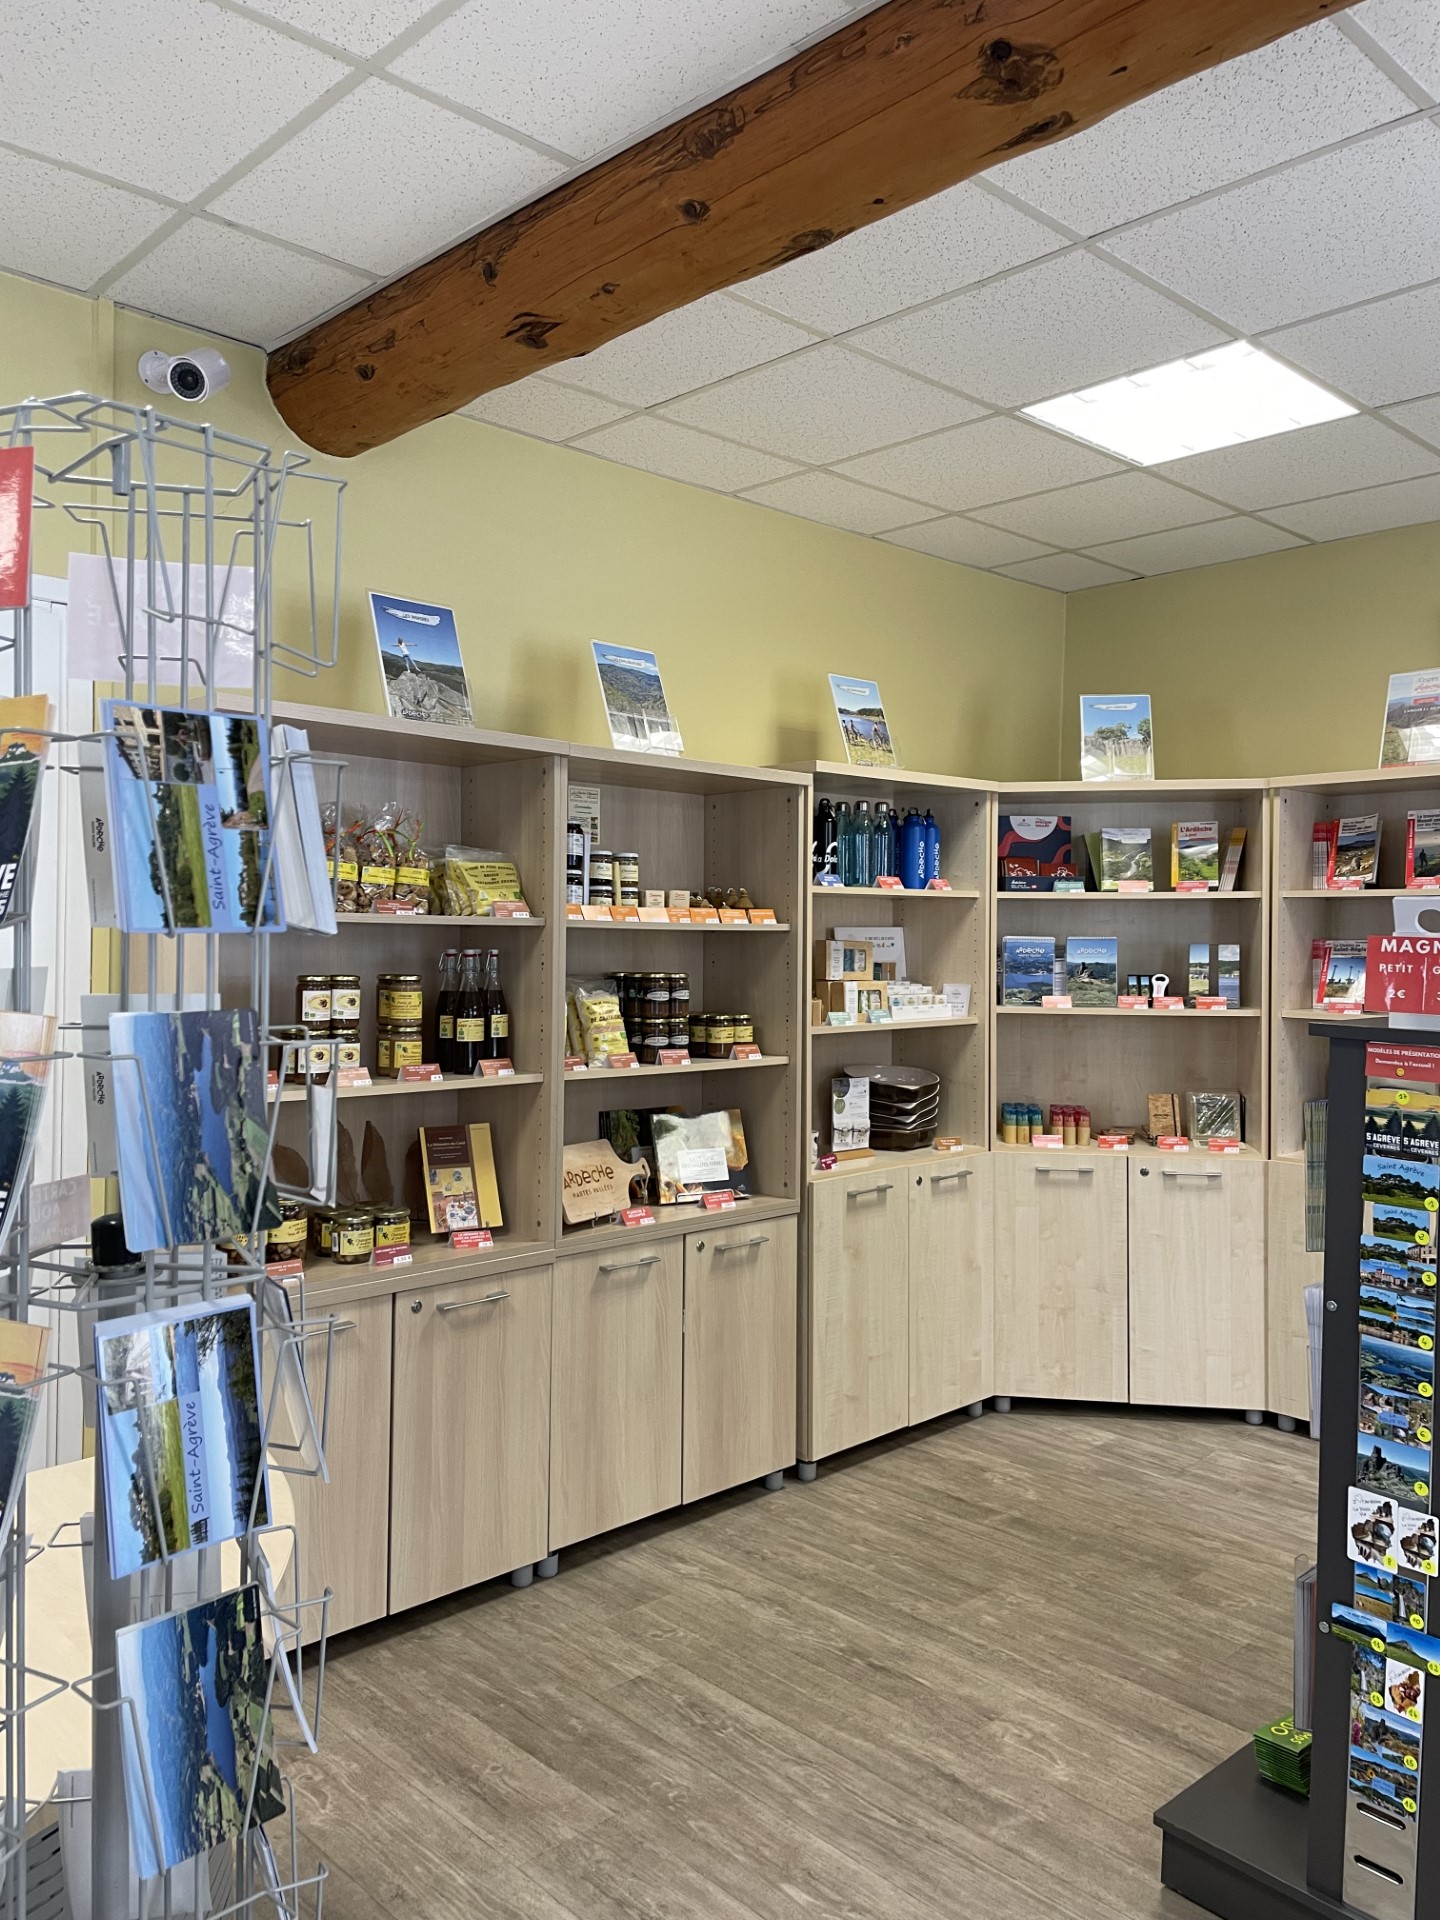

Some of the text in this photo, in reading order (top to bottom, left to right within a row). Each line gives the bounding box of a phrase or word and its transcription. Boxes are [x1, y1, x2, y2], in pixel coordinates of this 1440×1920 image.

[203, 803, 227, 910] Saint-Agrève
[1379, 963, 1414, 974] PETIT
[1367, 1046, 1393, 1056] MODÈLES
[1393, 1048, 1401, 1056] DE
[1377, 1162, 1425, 1178] Saint Agrève
[1426, 1274, 1432, 1282] 3
[1421, 1338, 1427, 1347] 4
[1421, 1384, 1428, 1393] 5
[182, 1400, 205, 1514] Saint-Agrève
